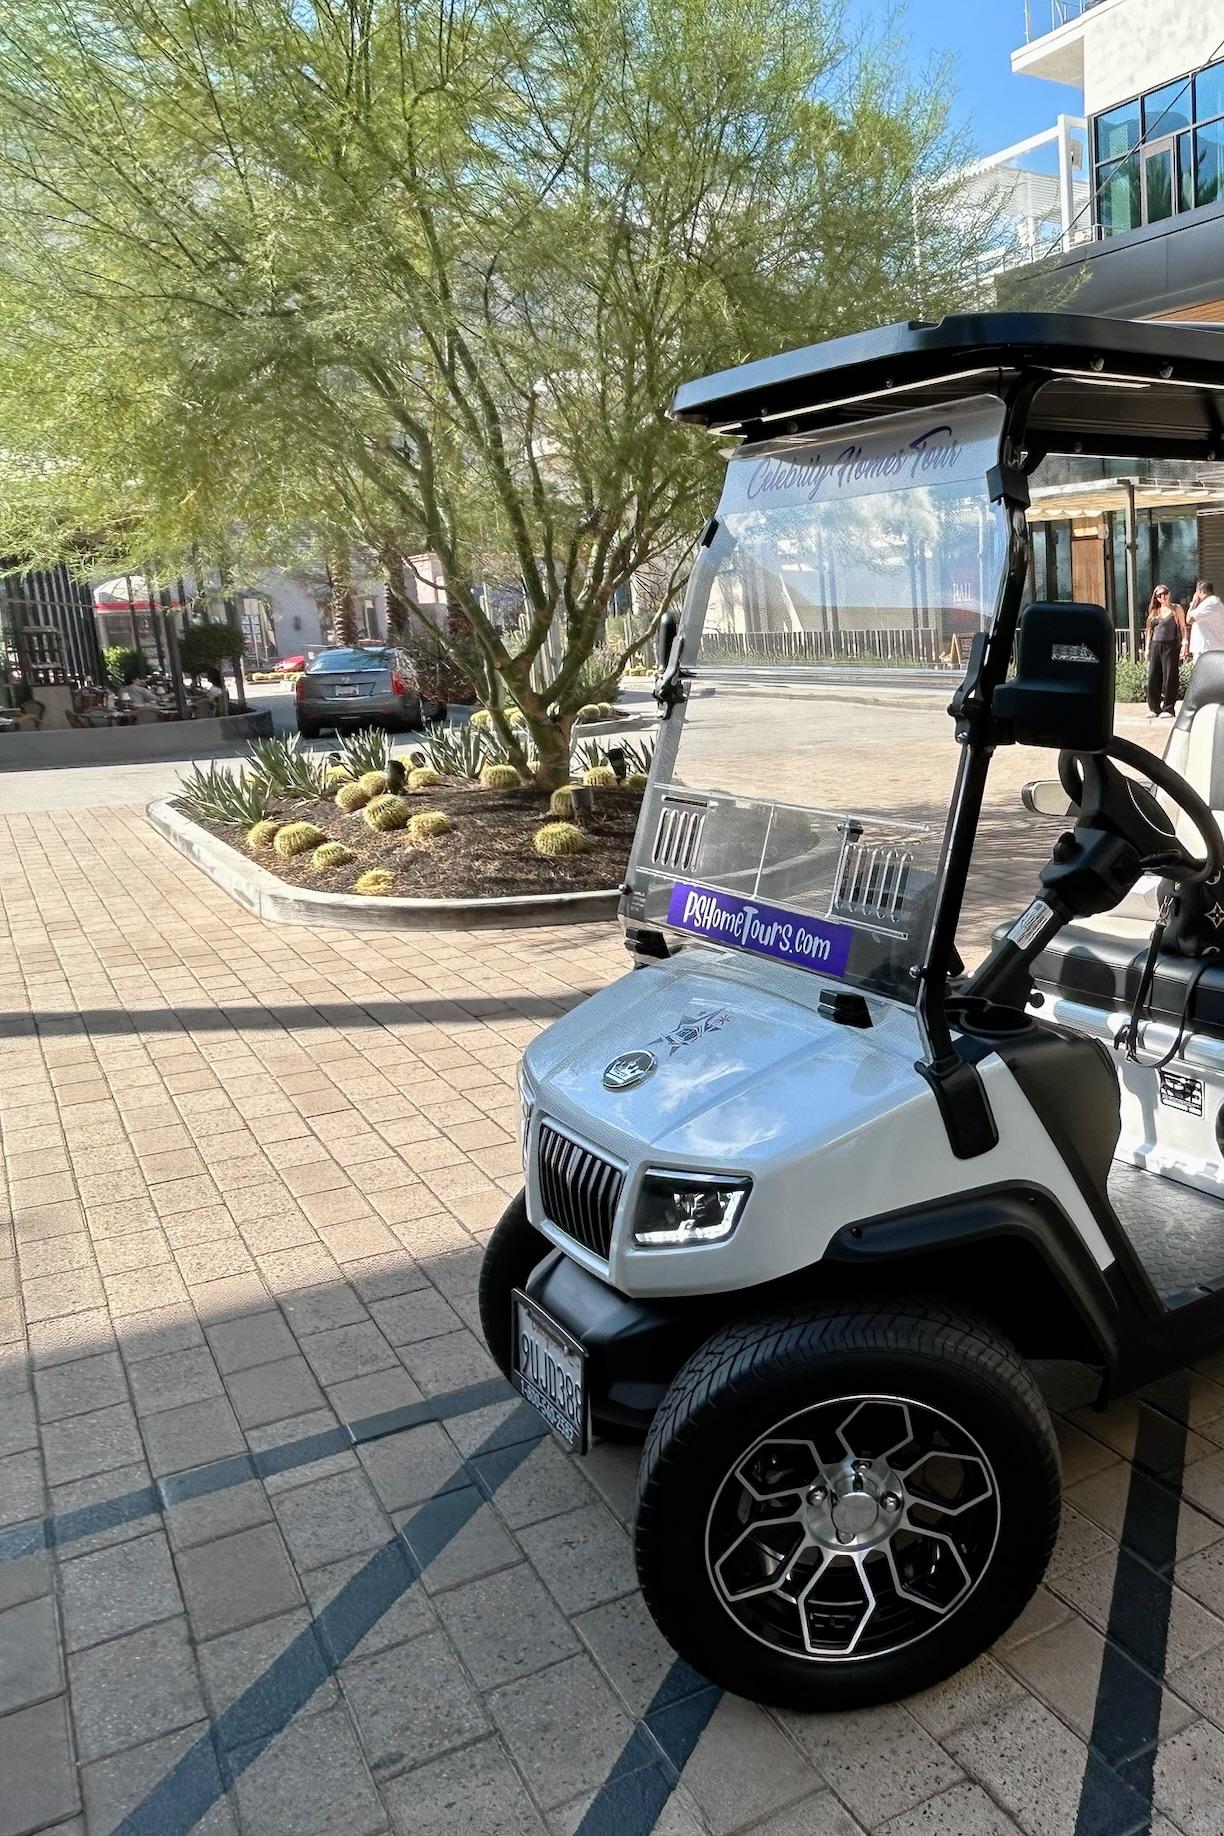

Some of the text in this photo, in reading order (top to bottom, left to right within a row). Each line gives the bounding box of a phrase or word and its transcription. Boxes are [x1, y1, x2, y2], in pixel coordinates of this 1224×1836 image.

[748, 426, 962, 500] Celebrity Homes Tour
[683, 891, 831, 960] PSHomeTours.com
